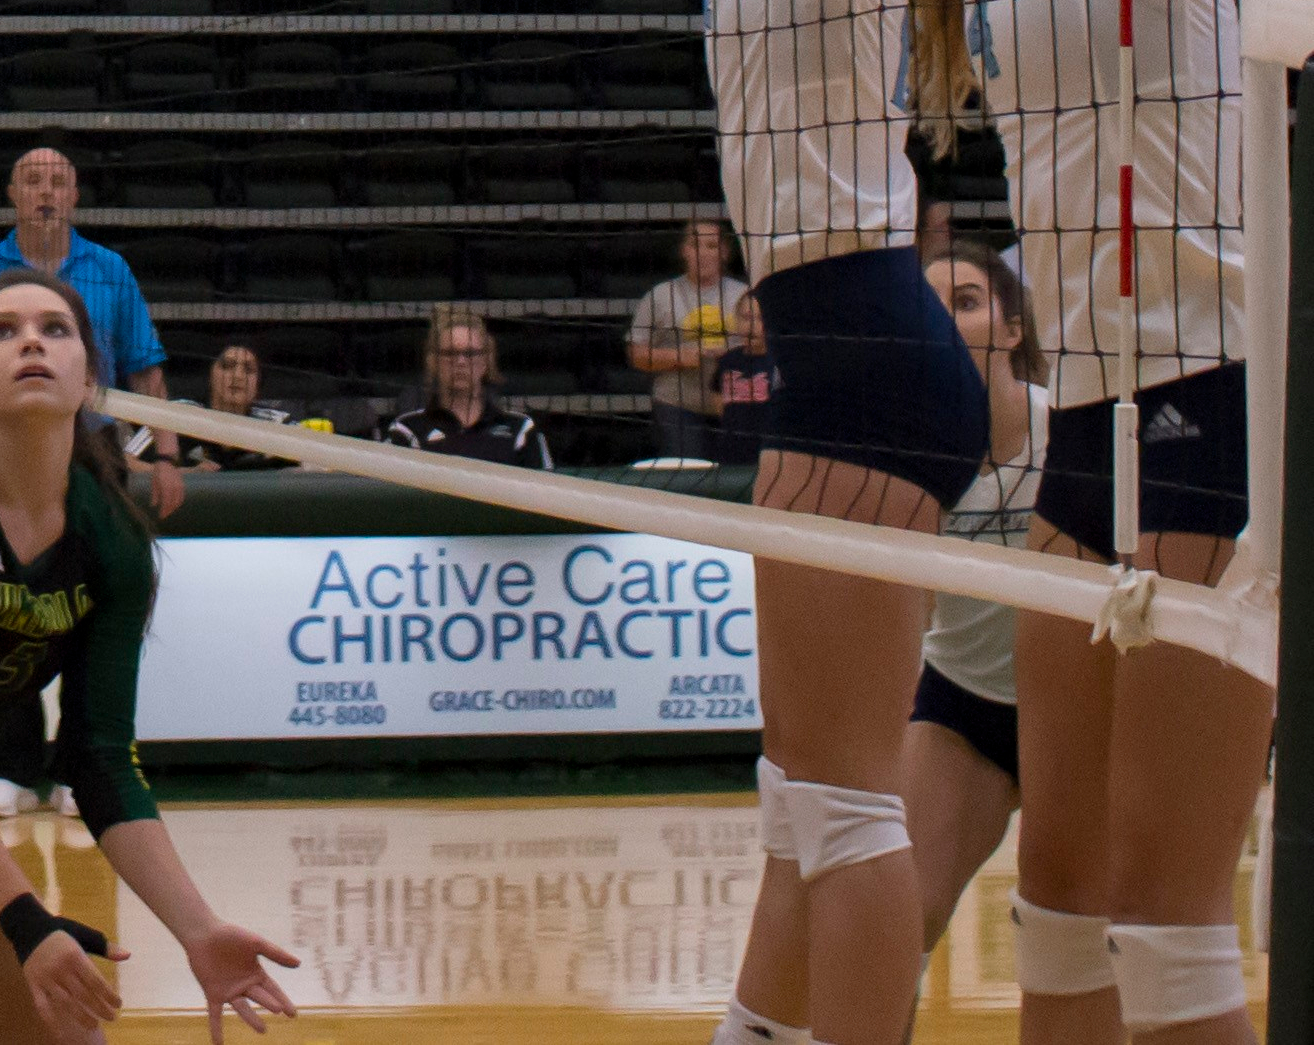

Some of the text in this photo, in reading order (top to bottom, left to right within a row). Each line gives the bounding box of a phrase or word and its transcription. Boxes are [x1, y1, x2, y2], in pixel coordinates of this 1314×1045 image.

[310, 544, 731, 609] Active Care
[287, 608, 752, 665] CHIROPRACTIC
[296, 681, 378, 703] EUREKA
[668, 674, 746, 696] ARCATA
[429, 689, 616, 712] GRACE-CHIRO.COM
[658, 698, 756, 719] 822-2224
